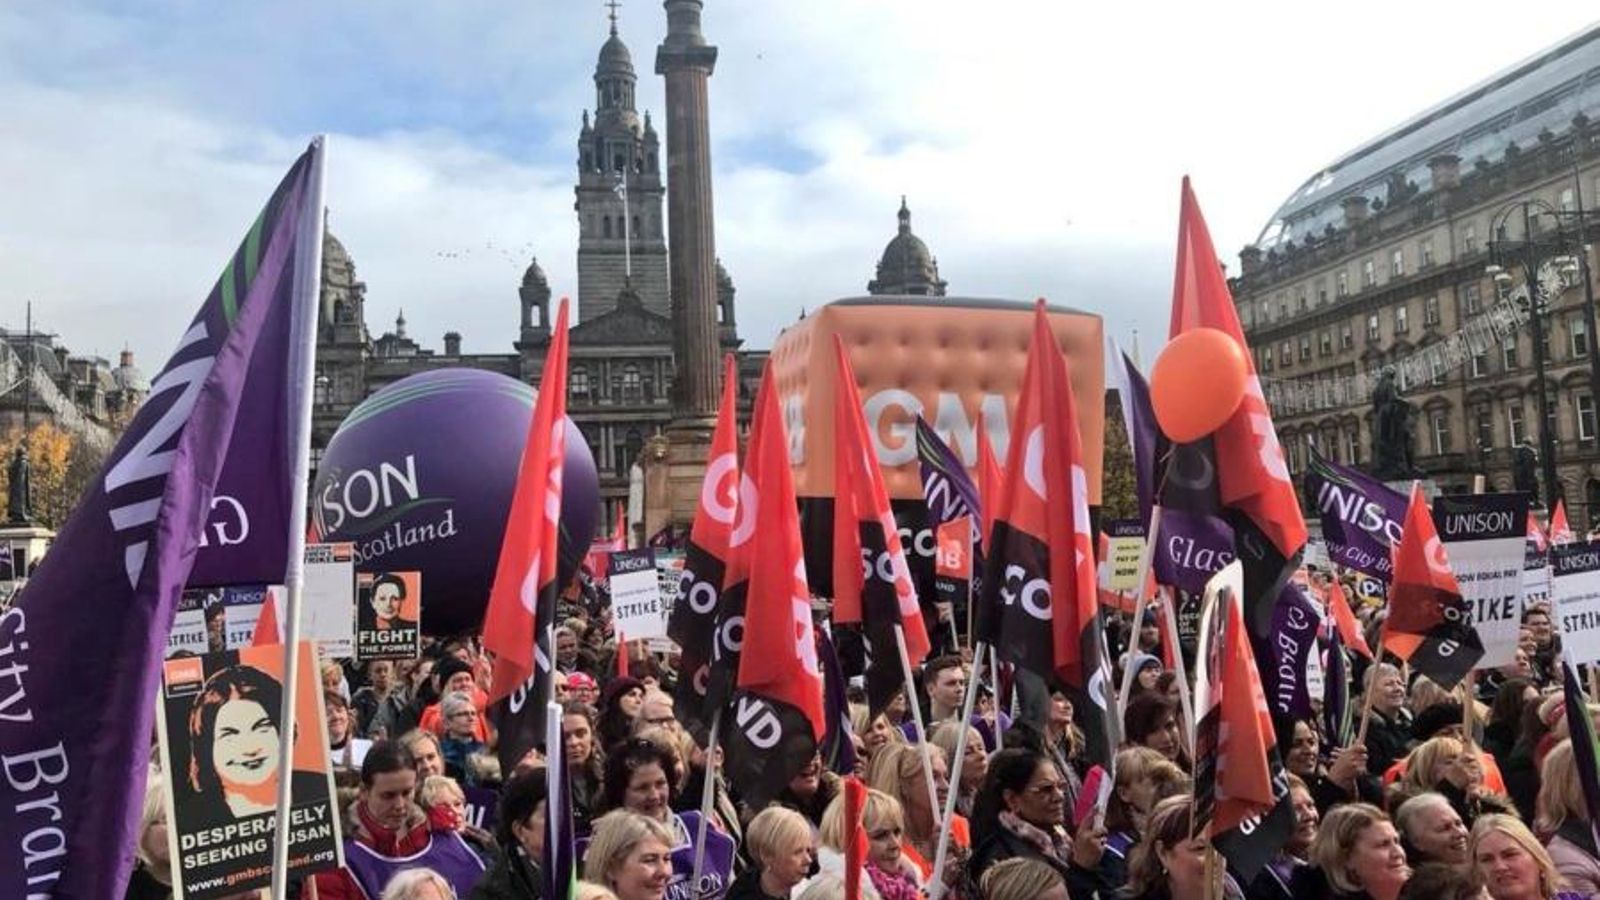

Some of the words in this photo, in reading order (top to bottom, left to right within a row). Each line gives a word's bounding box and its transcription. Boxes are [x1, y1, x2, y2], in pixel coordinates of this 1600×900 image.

[1446, 512, 1514, 535] UNISON
[354, 509, 459, 567] Scotland
[615, 557, 650, 571] UNISON
[617, 601, 657, 620] STRIKE
[359, 630, 416, 644] FIGHT
[360, 646, 381, 654] THE
[382, 644, 415, 654] POWER
[180, 803, 327, 851] DESPERAELY
[183, 838, 268, 869] SEEKING
[272, 823, 332, 846] USAN
